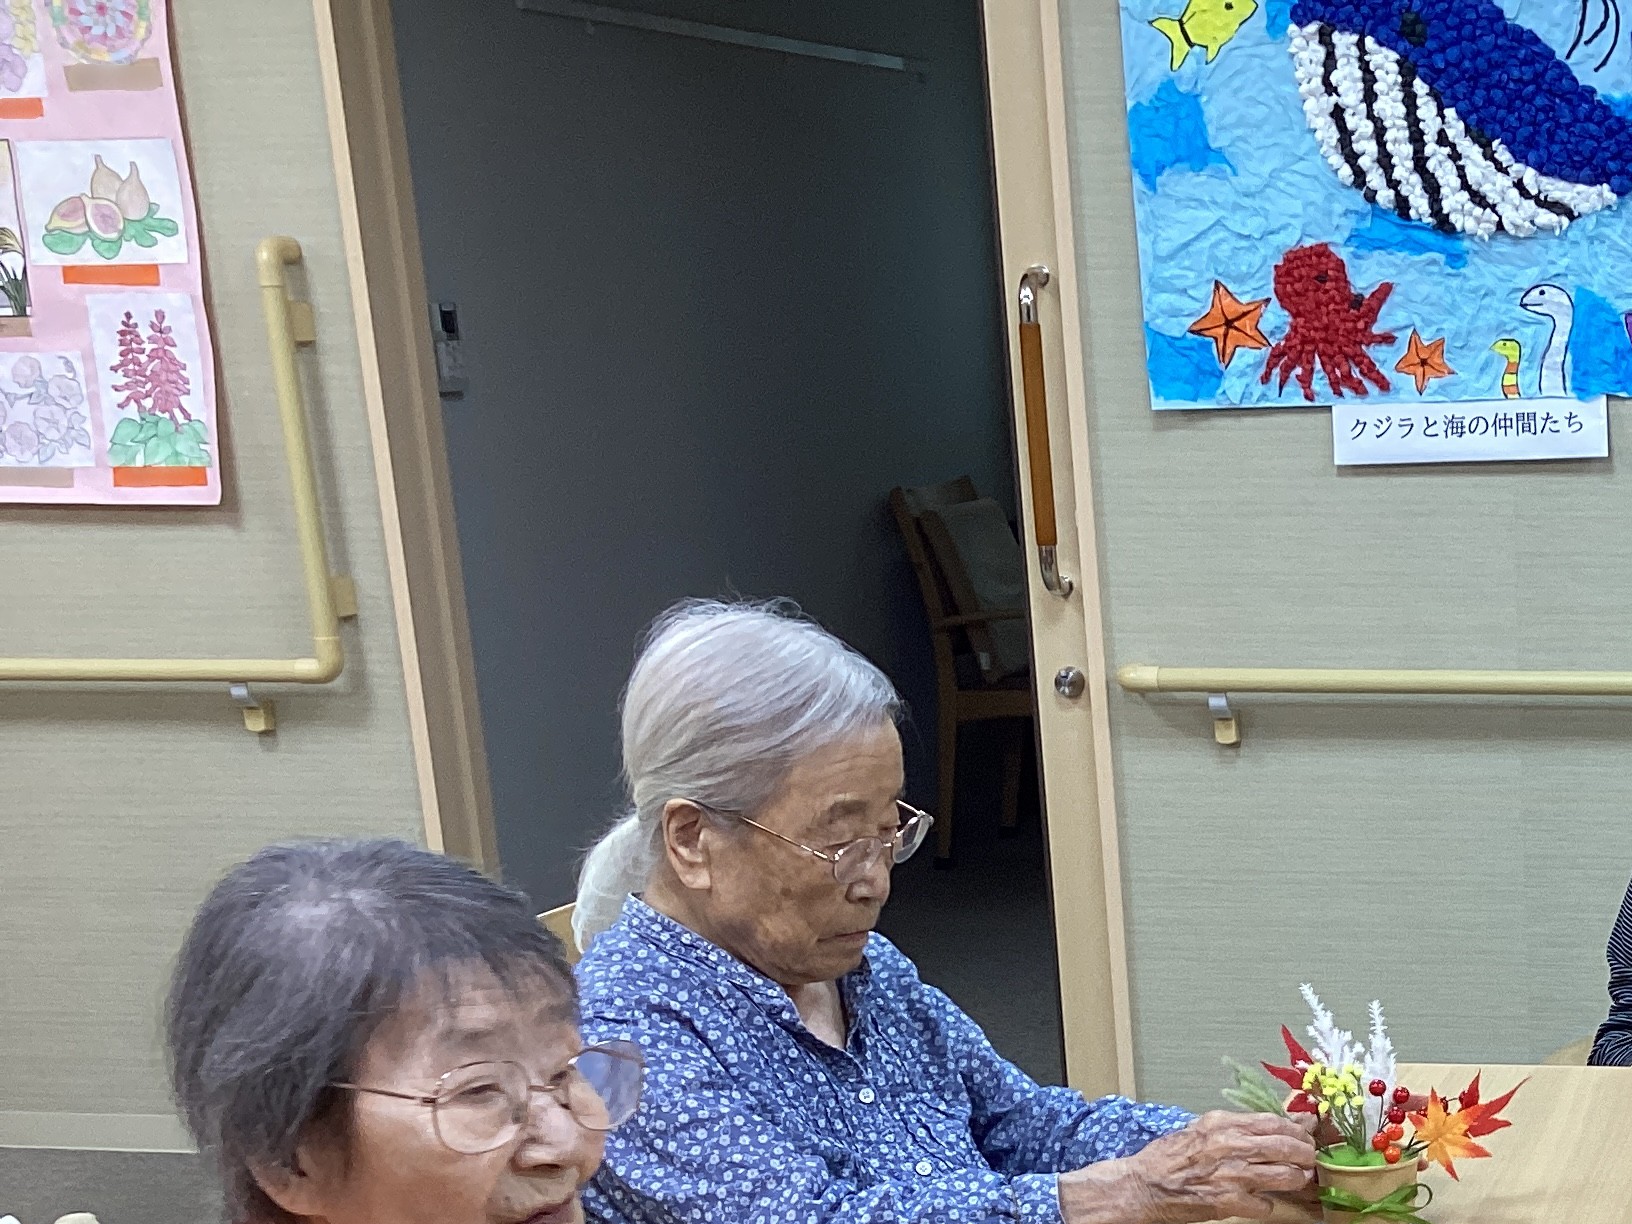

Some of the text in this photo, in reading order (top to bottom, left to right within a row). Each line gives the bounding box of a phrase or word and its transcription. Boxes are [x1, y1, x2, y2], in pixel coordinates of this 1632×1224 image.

[1350, 411, 1584, 440] クジラと海の仲間たち
